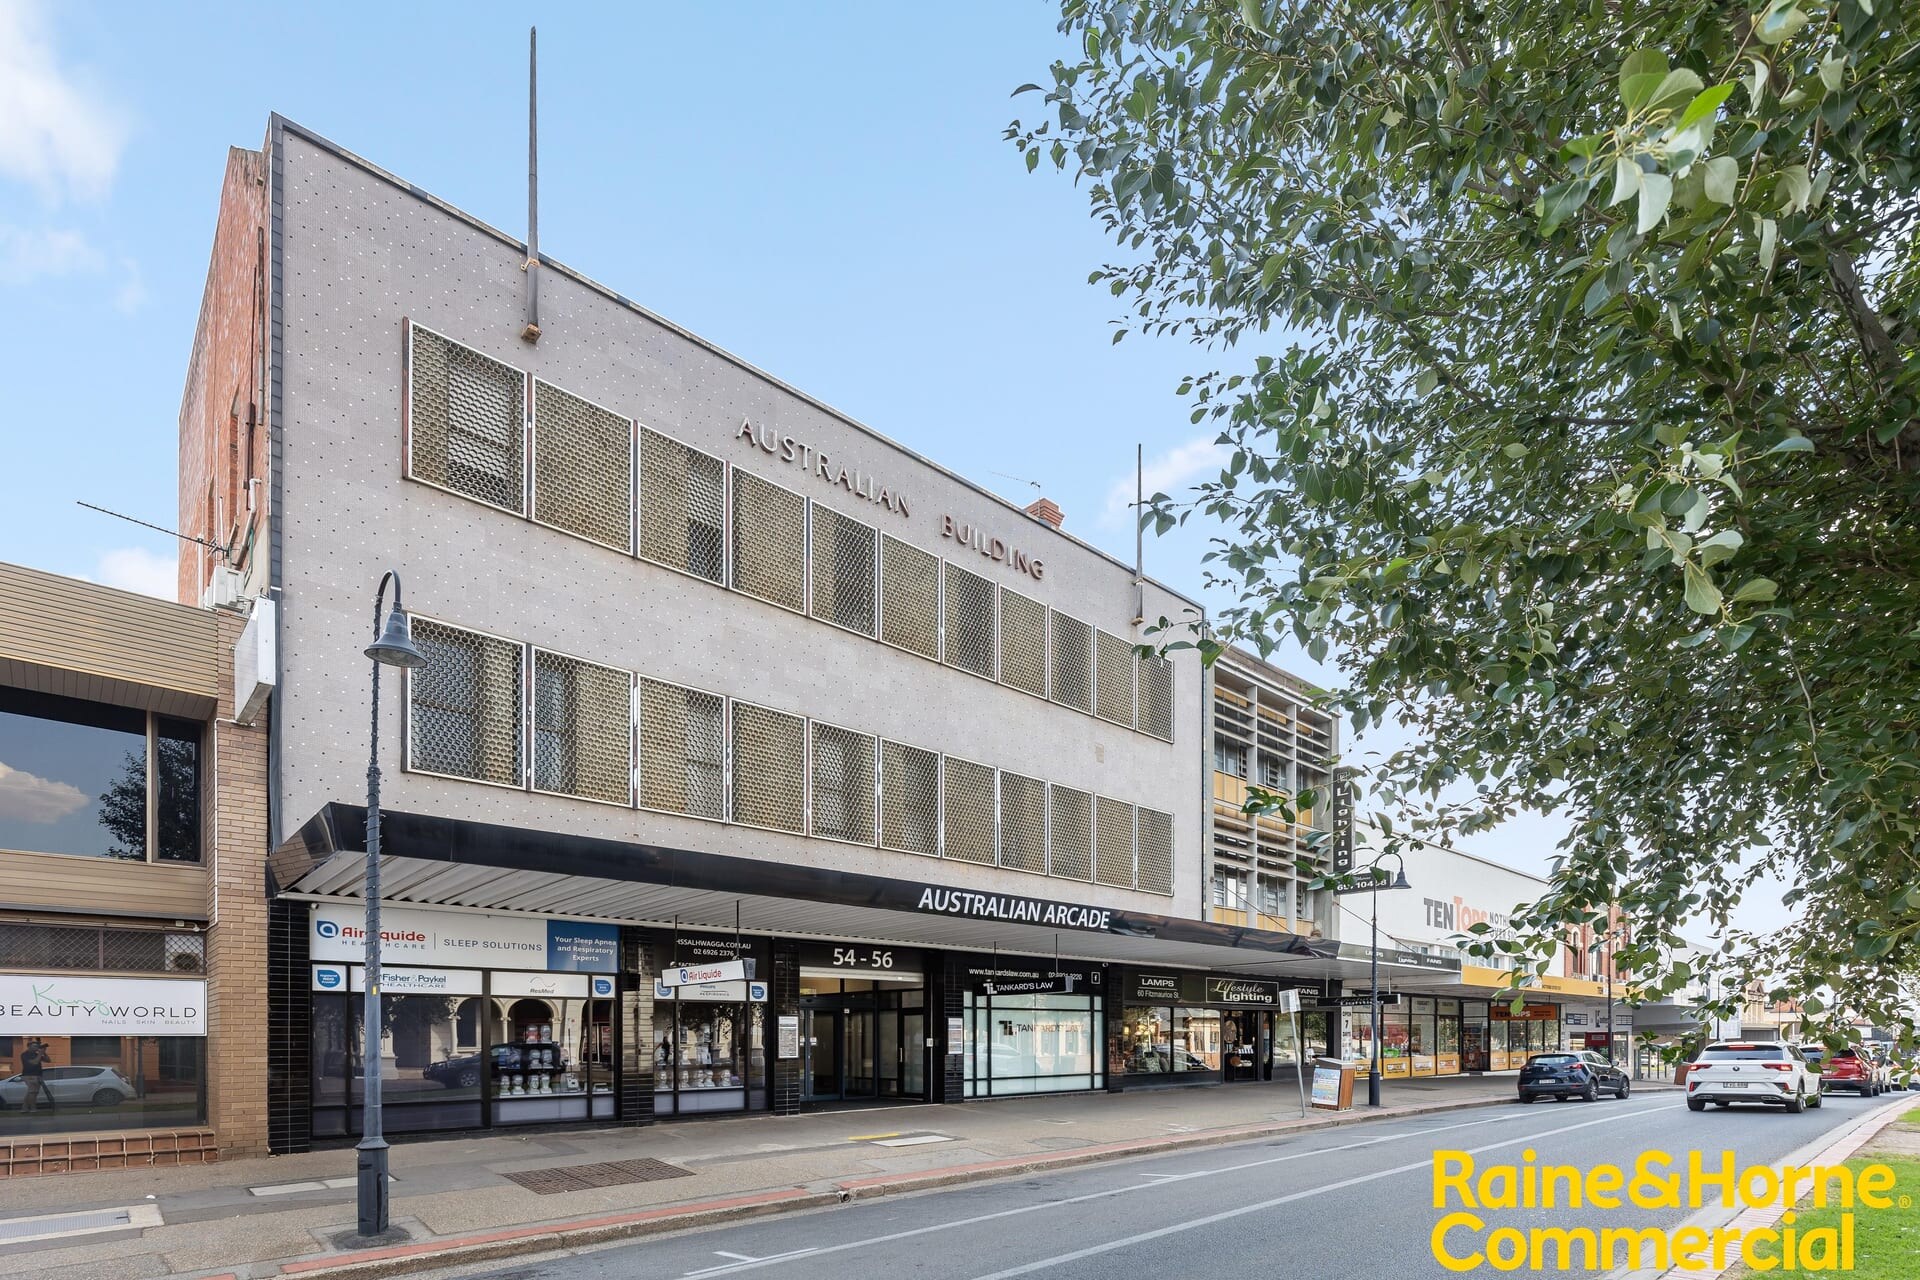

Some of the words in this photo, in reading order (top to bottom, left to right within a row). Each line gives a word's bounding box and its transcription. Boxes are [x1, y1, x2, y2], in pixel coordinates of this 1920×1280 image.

[736, 416, 910, 517] AUSTRALIAN
[941, 513, 1044, 580] BUILDING
[918, 887, 1041, 922] AUSTRALIAN
[1043, 904, 1111, 930] ARCADE
[342, 927, 366, 938] Air
[342, 940, 426, 950] HEAHCARE
[443, 938, 479, 948] SLEEP
[482, 940, 543, 952] SOLUTIONS
[554, 936, 572, 944] Your
[573, 936, 593, 946] Sleep
[594, 938, 617, 947] Apnea
[557, 944, 571, 952] and
[572, 945, 614, 956] Respiratory
[693, 948, 702, 956] 02
[702, 949, 718, 957] 6926
[572, 954, 600, 963] Experts
[833, 947, 857, 967] 54
[871, 950, 893, 969] 56
[382, 973, 410, 982] Fisher
[418, 974, 447, 985] Paykel
[689, 971, 698, 981] Air
[698, 968, 722, 981] Liquide
[996, 983, 1035, 992] TANKARD'S
[1035, 981, 1054, 989] LAW
[1141, 979, 1175, 988] LAMPS
[1210, 980, 1265, 993] Lifestyle
[529, 987, 555, 995] ResMed
[1146, 990, 1173, 999] Fitzmaurice
[1223, 990, 1273, 1003] Lighting
[110, 1006, 197, 1018] WORLD
